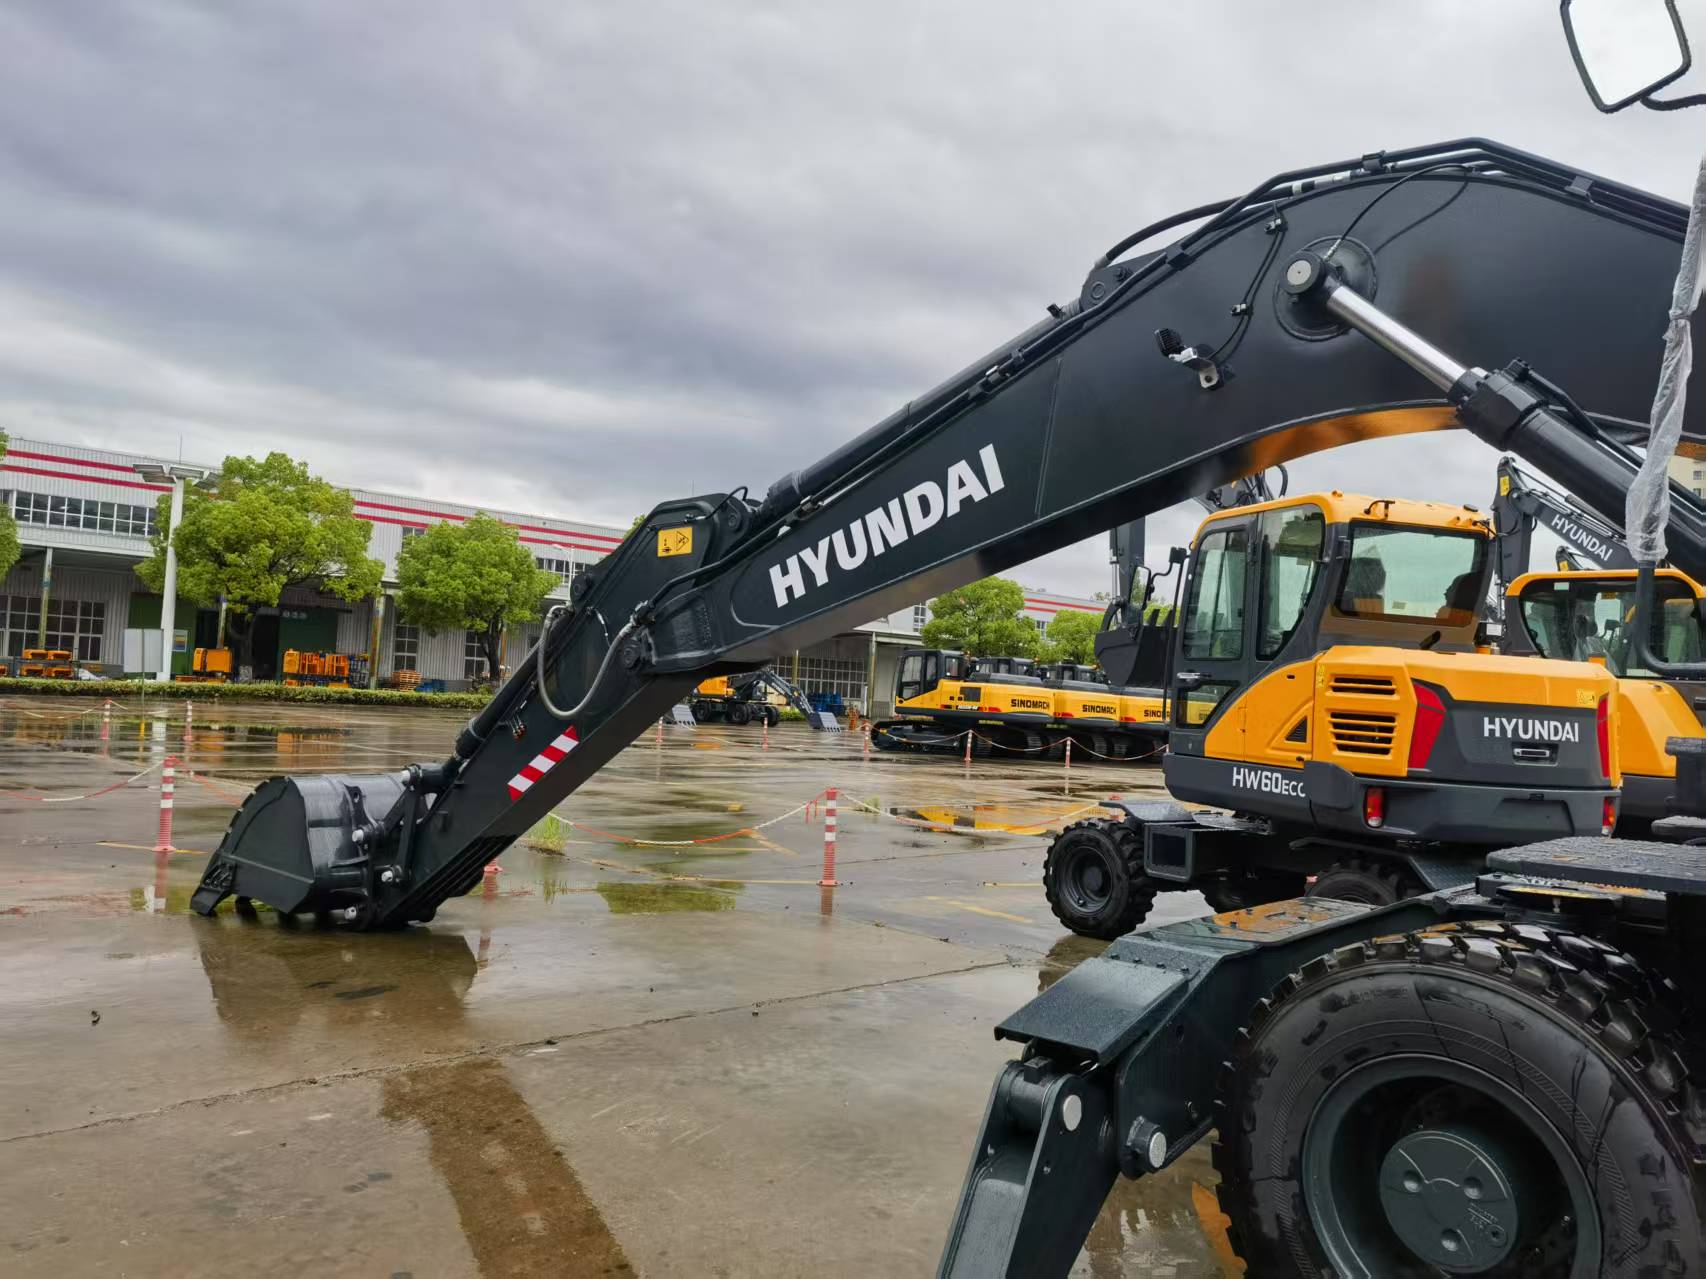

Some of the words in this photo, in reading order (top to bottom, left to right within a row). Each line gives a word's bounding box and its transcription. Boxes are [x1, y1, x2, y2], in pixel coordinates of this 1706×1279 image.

[769, 443, 1005, 608] HYUNDAI
[1551, 514, 1613, 561] HYUNDAI
[1011, 698, 1050, 710] SINOMACH
[1082, 704, 1117, 715] SINOMACH
[1483, 717, 1579, 742] HYUNDAI
